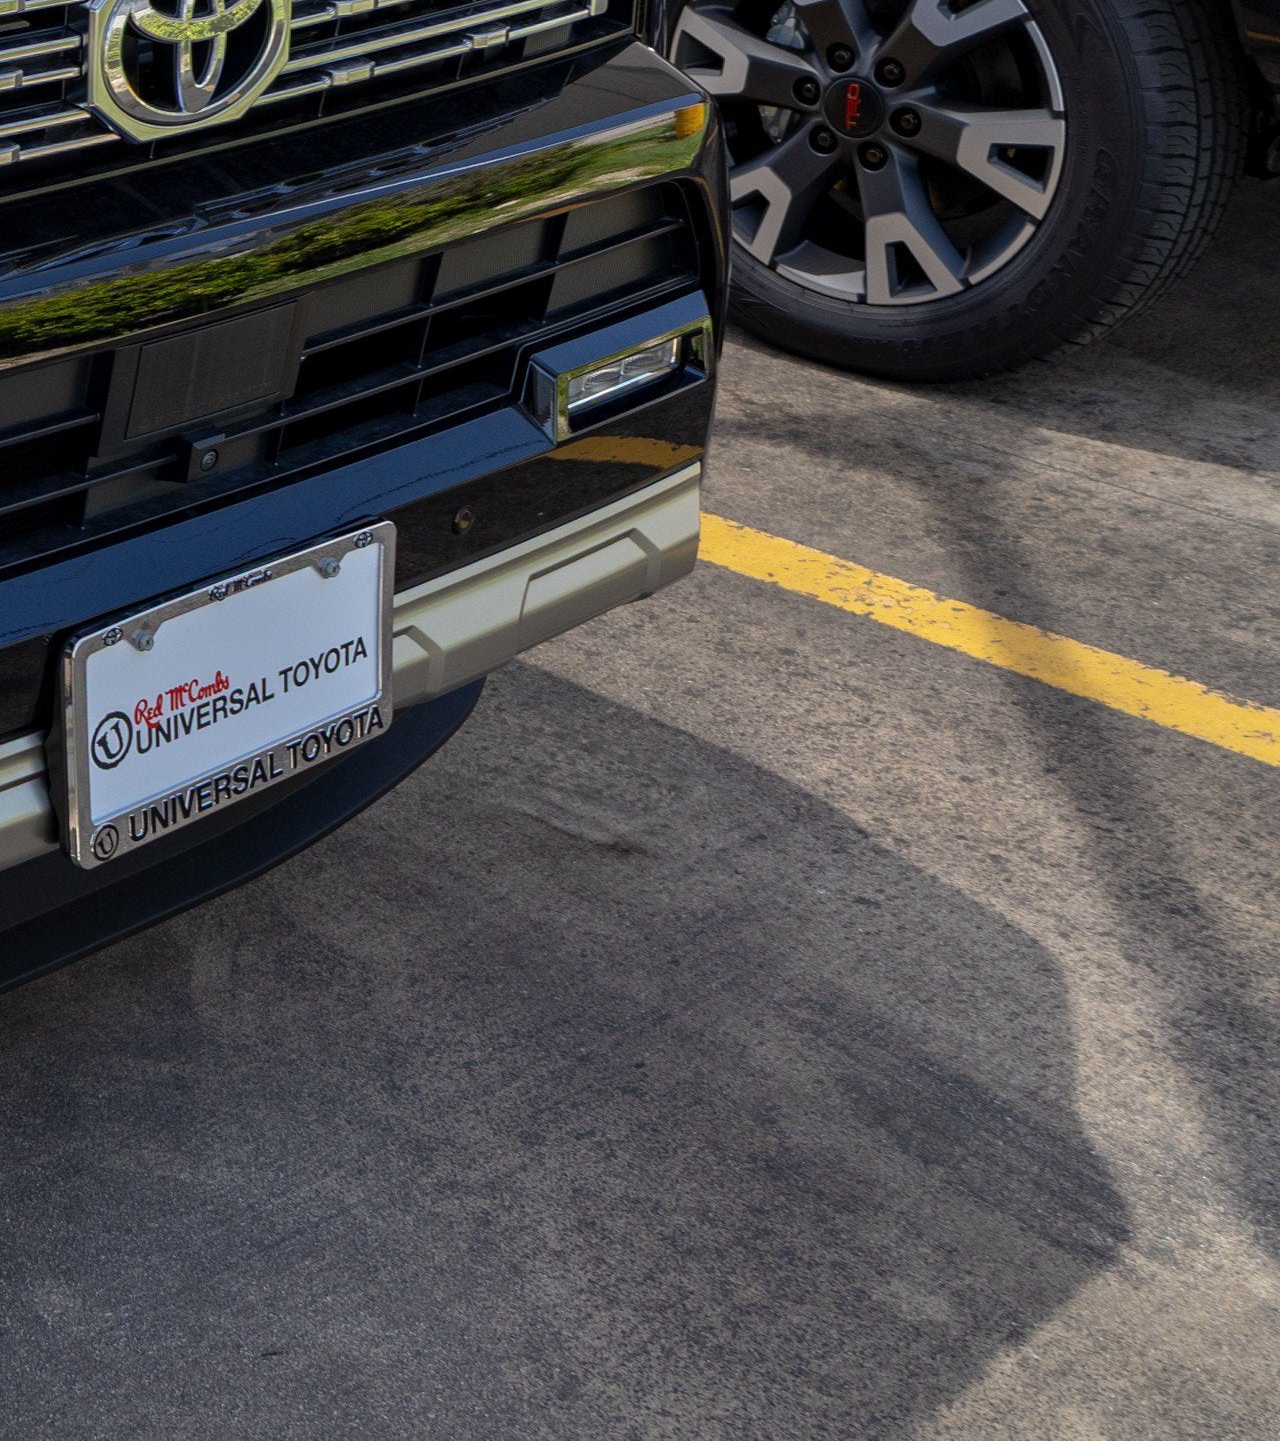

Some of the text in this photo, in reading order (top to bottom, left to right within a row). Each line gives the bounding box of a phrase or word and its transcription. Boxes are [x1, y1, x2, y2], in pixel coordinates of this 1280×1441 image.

[844, 82, 862, 132] TRD
[133, 669, 230, 730] Red McCombs
[135, 636, 368, 755] UNIVERSAL TOYOTA
[128, 704, 385, 842] UNIVERSAL TOYOTA
